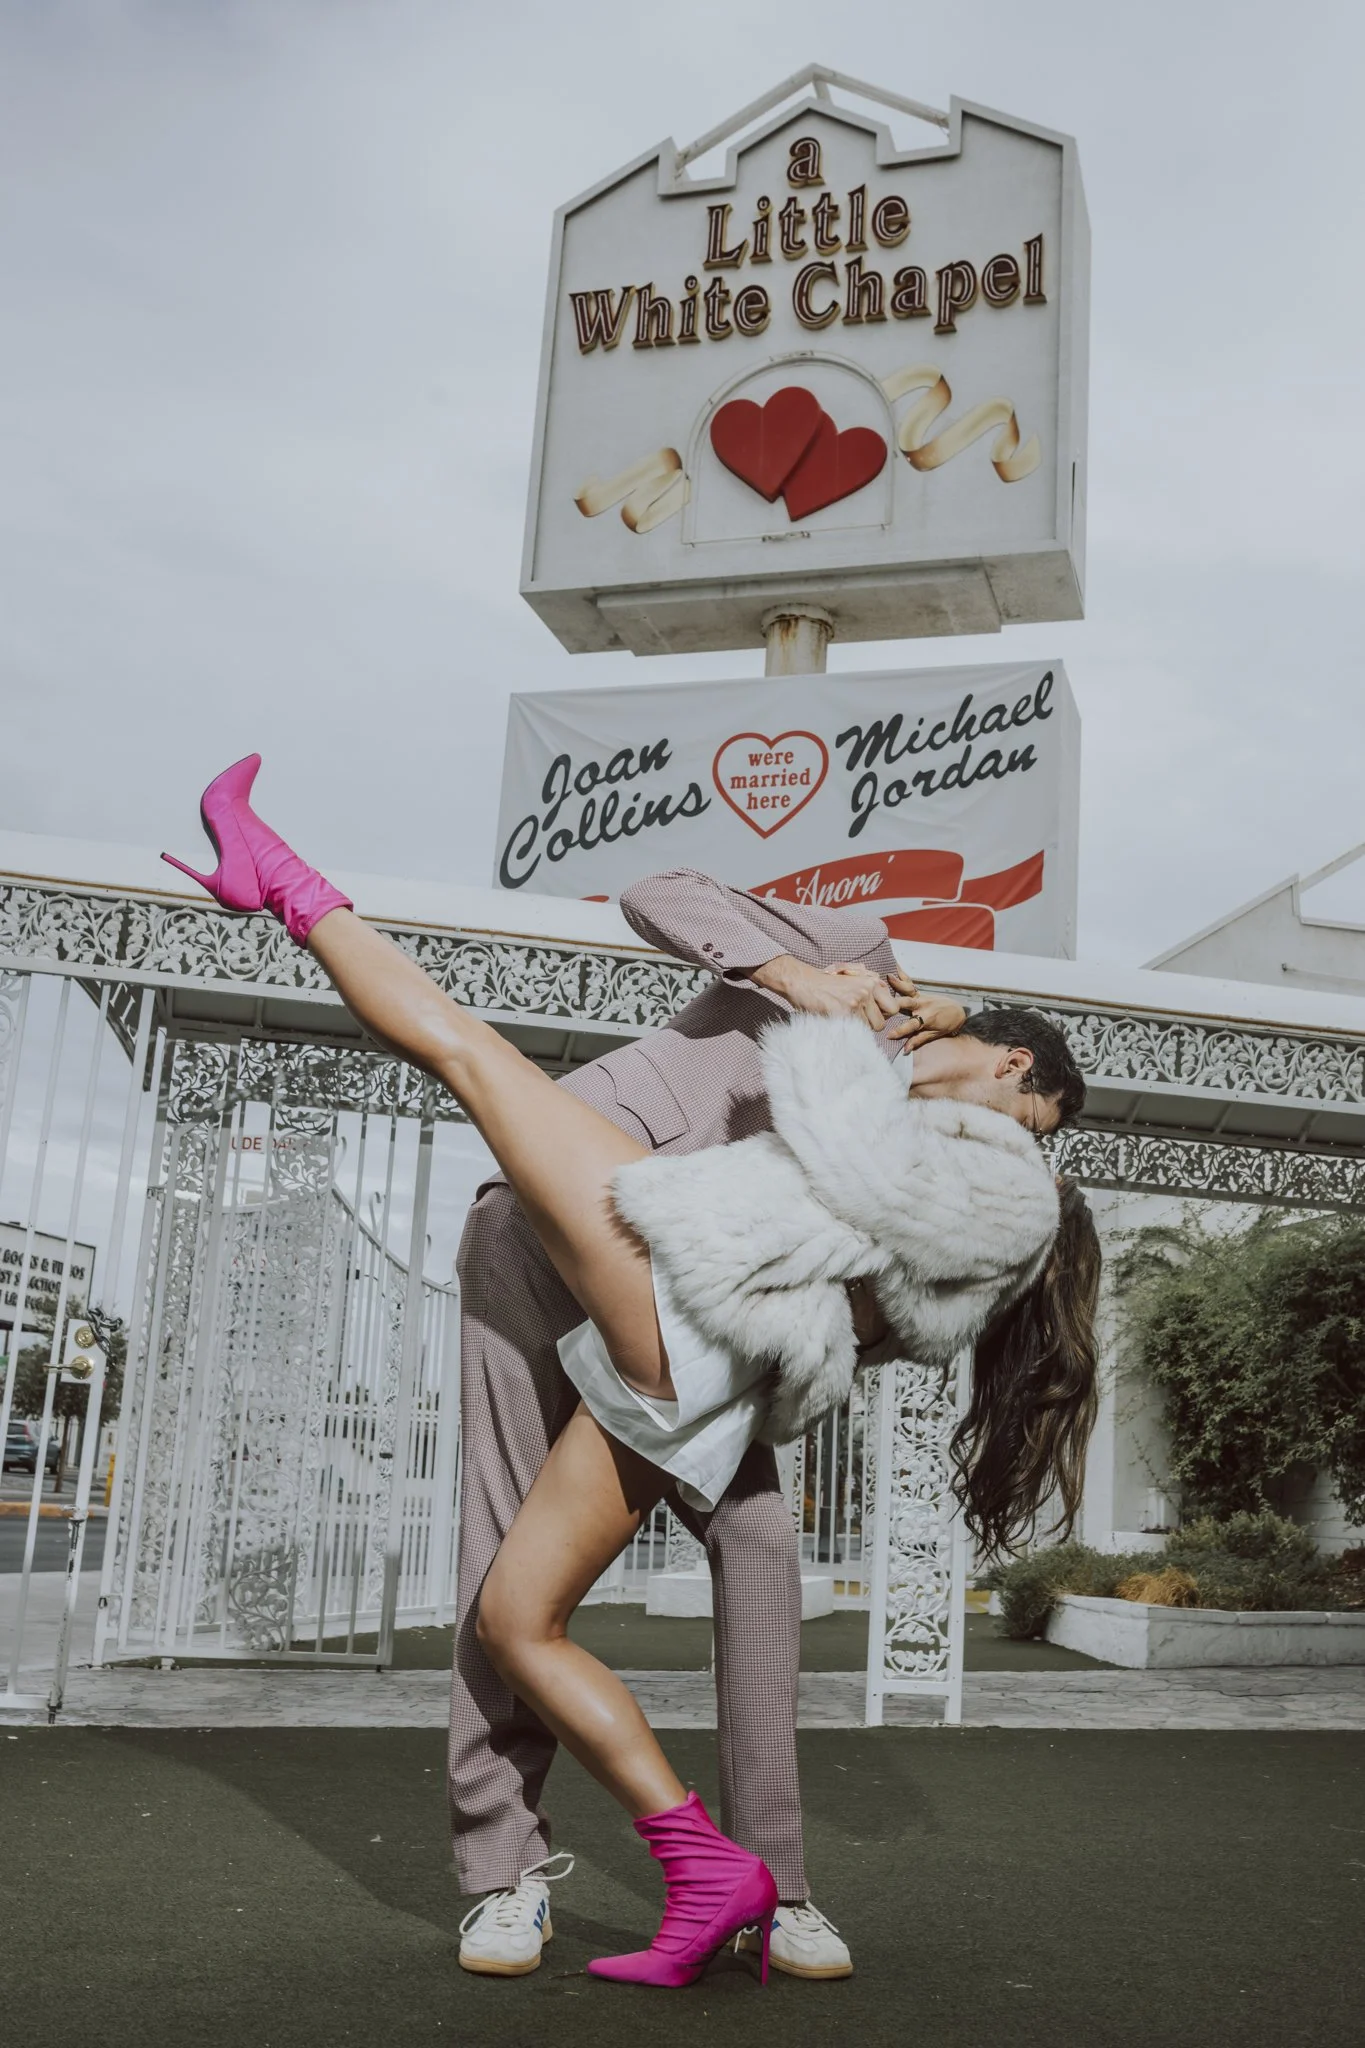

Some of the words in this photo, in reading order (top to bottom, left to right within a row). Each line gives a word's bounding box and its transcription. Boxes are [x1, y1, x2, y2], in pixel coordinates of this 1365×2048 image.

[787, 137, 825, 189] a
[703, 184, 911, 270] Little
[569, 275, 771, 354] White
[793, 233, 1047, 335] Chapel
[748, 751, 794, 767] were
[835, 671, 1053, 771] Michael
[542, 738, 672, 831] Joan
[730, 767, 811, 790] married
[747, 792, 791, 810] here
[848, 744, 1037, 838] Jordan
[500, 782, 711, 889] Collins
